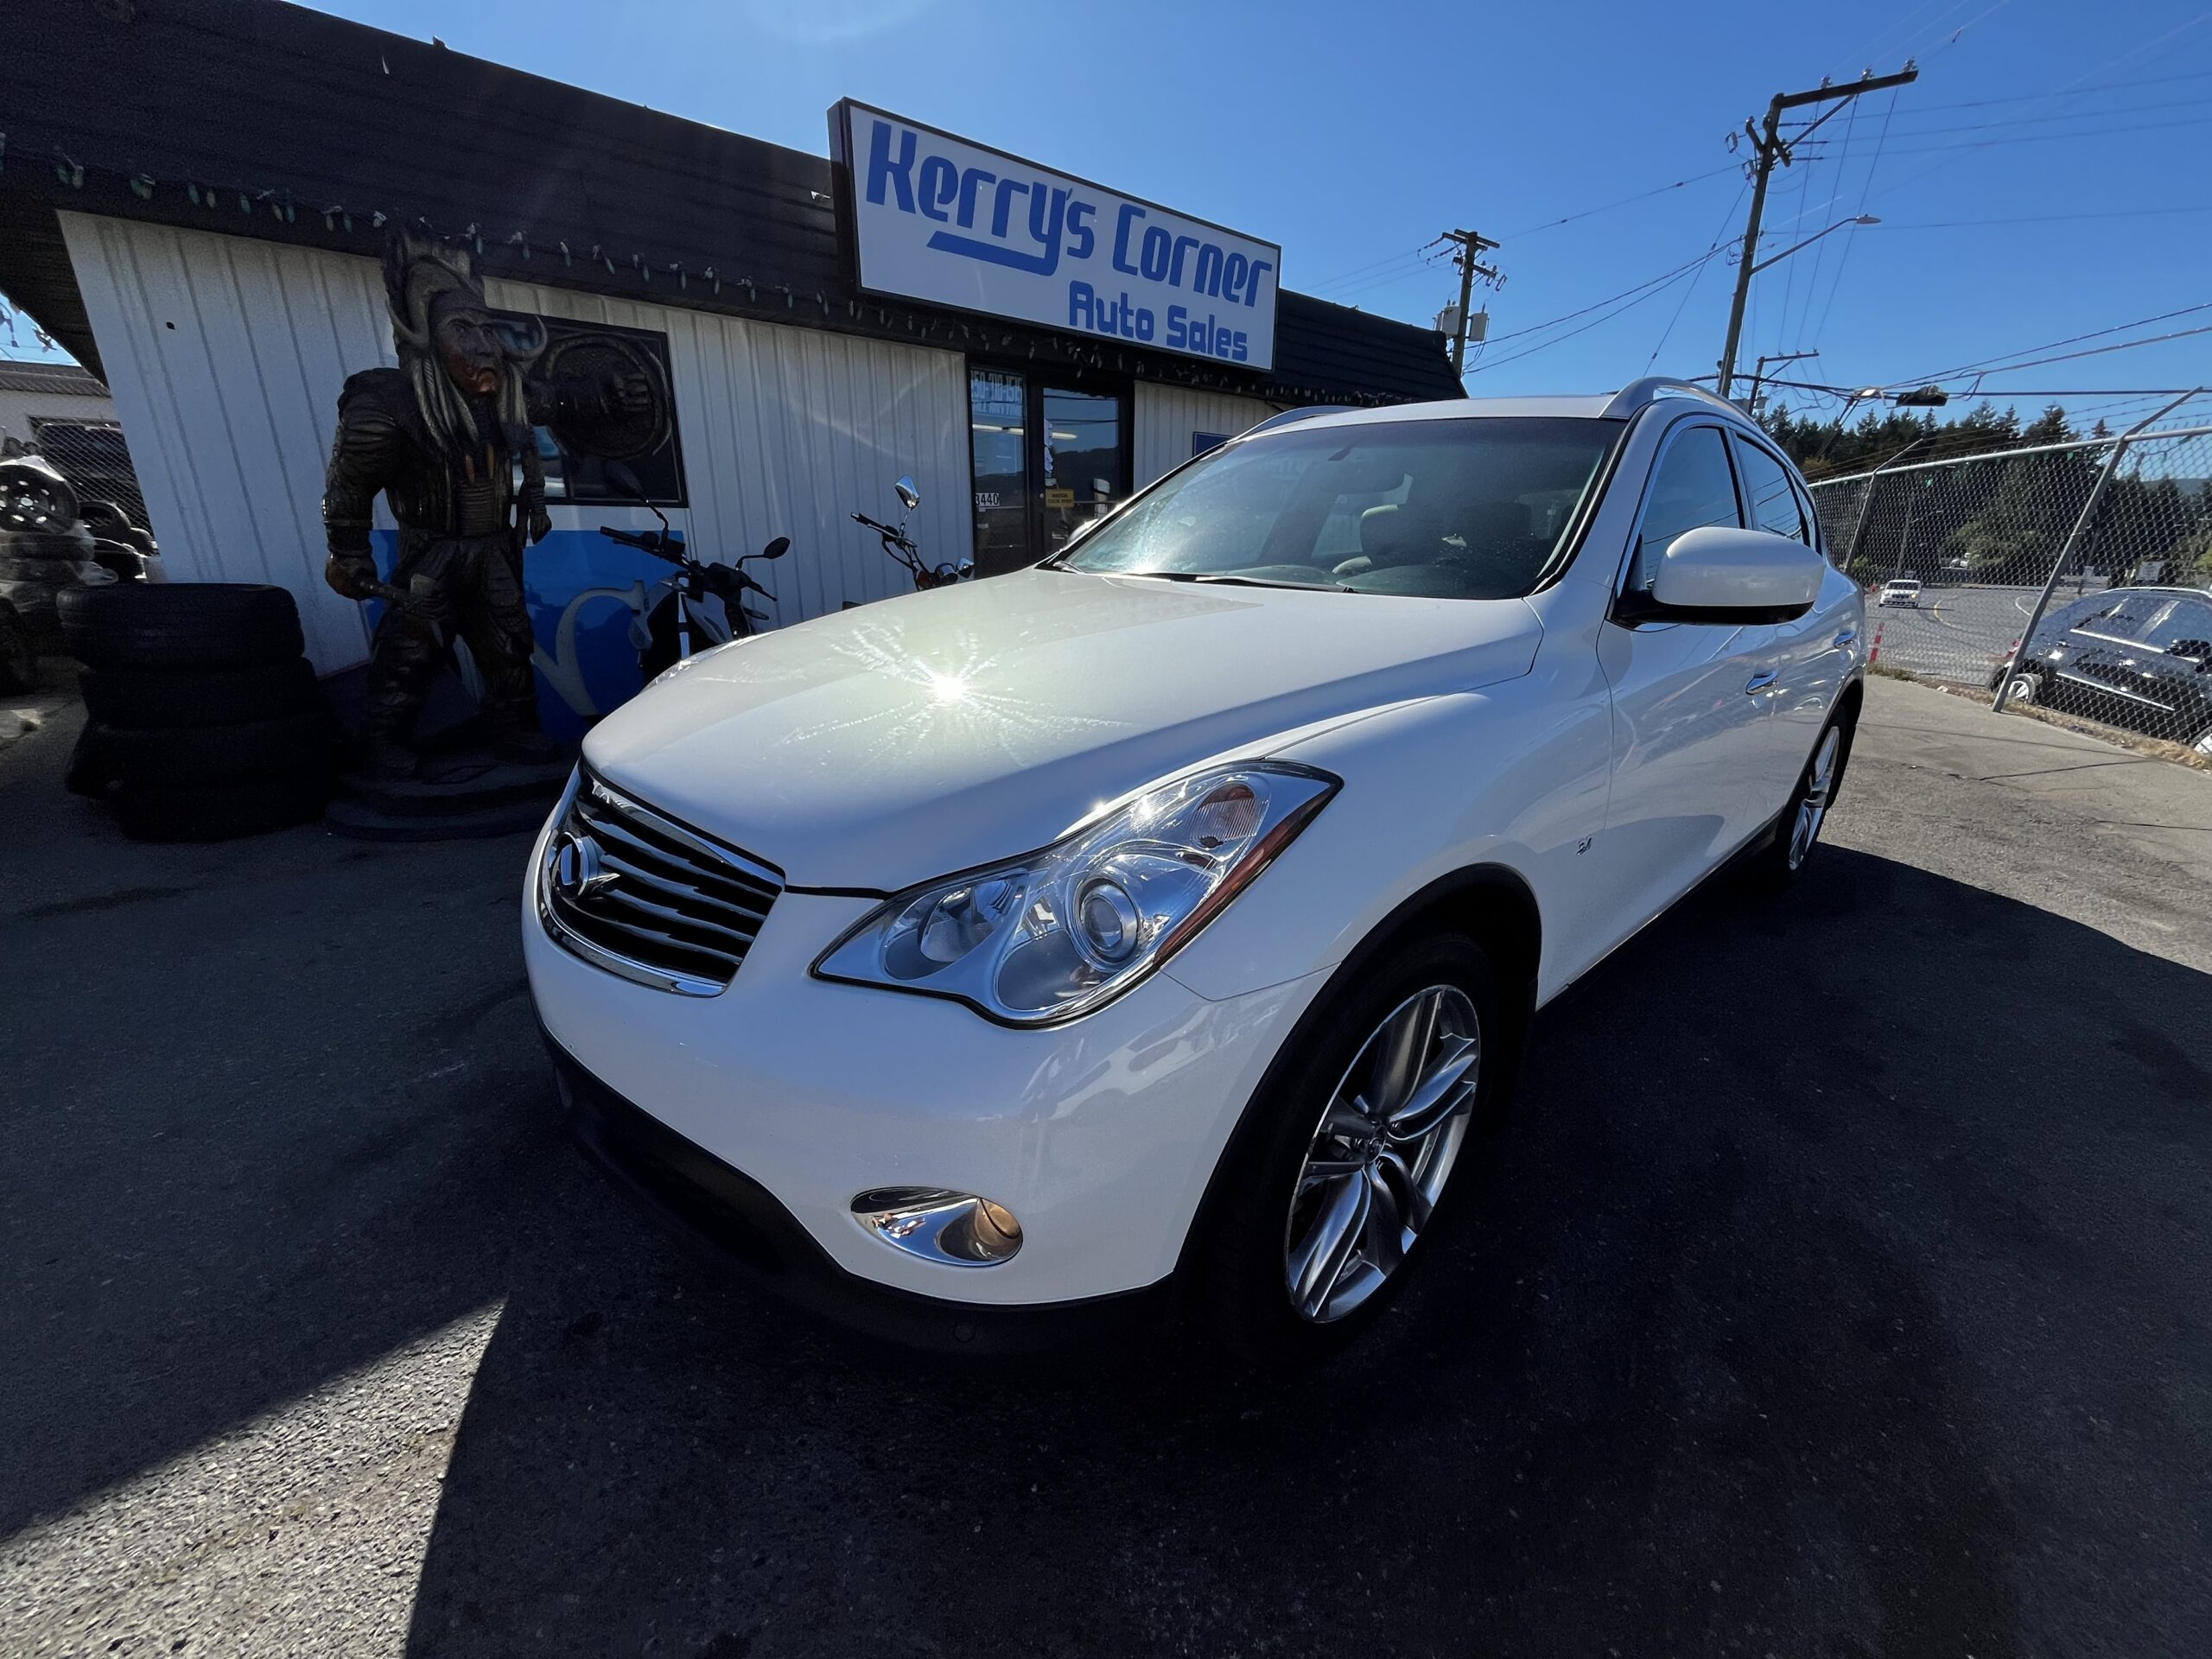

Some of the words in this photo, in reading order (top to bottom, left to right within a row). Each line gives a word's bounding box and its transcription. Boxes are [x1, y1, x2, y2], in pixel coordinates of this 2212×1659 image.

[867, 119, 1096, 276] Kerry's
[1112, 203, 1273, 308] Corner
[1069, 280, 1154, 342] Auto
[1166, 305, 1249, 362] Sales
